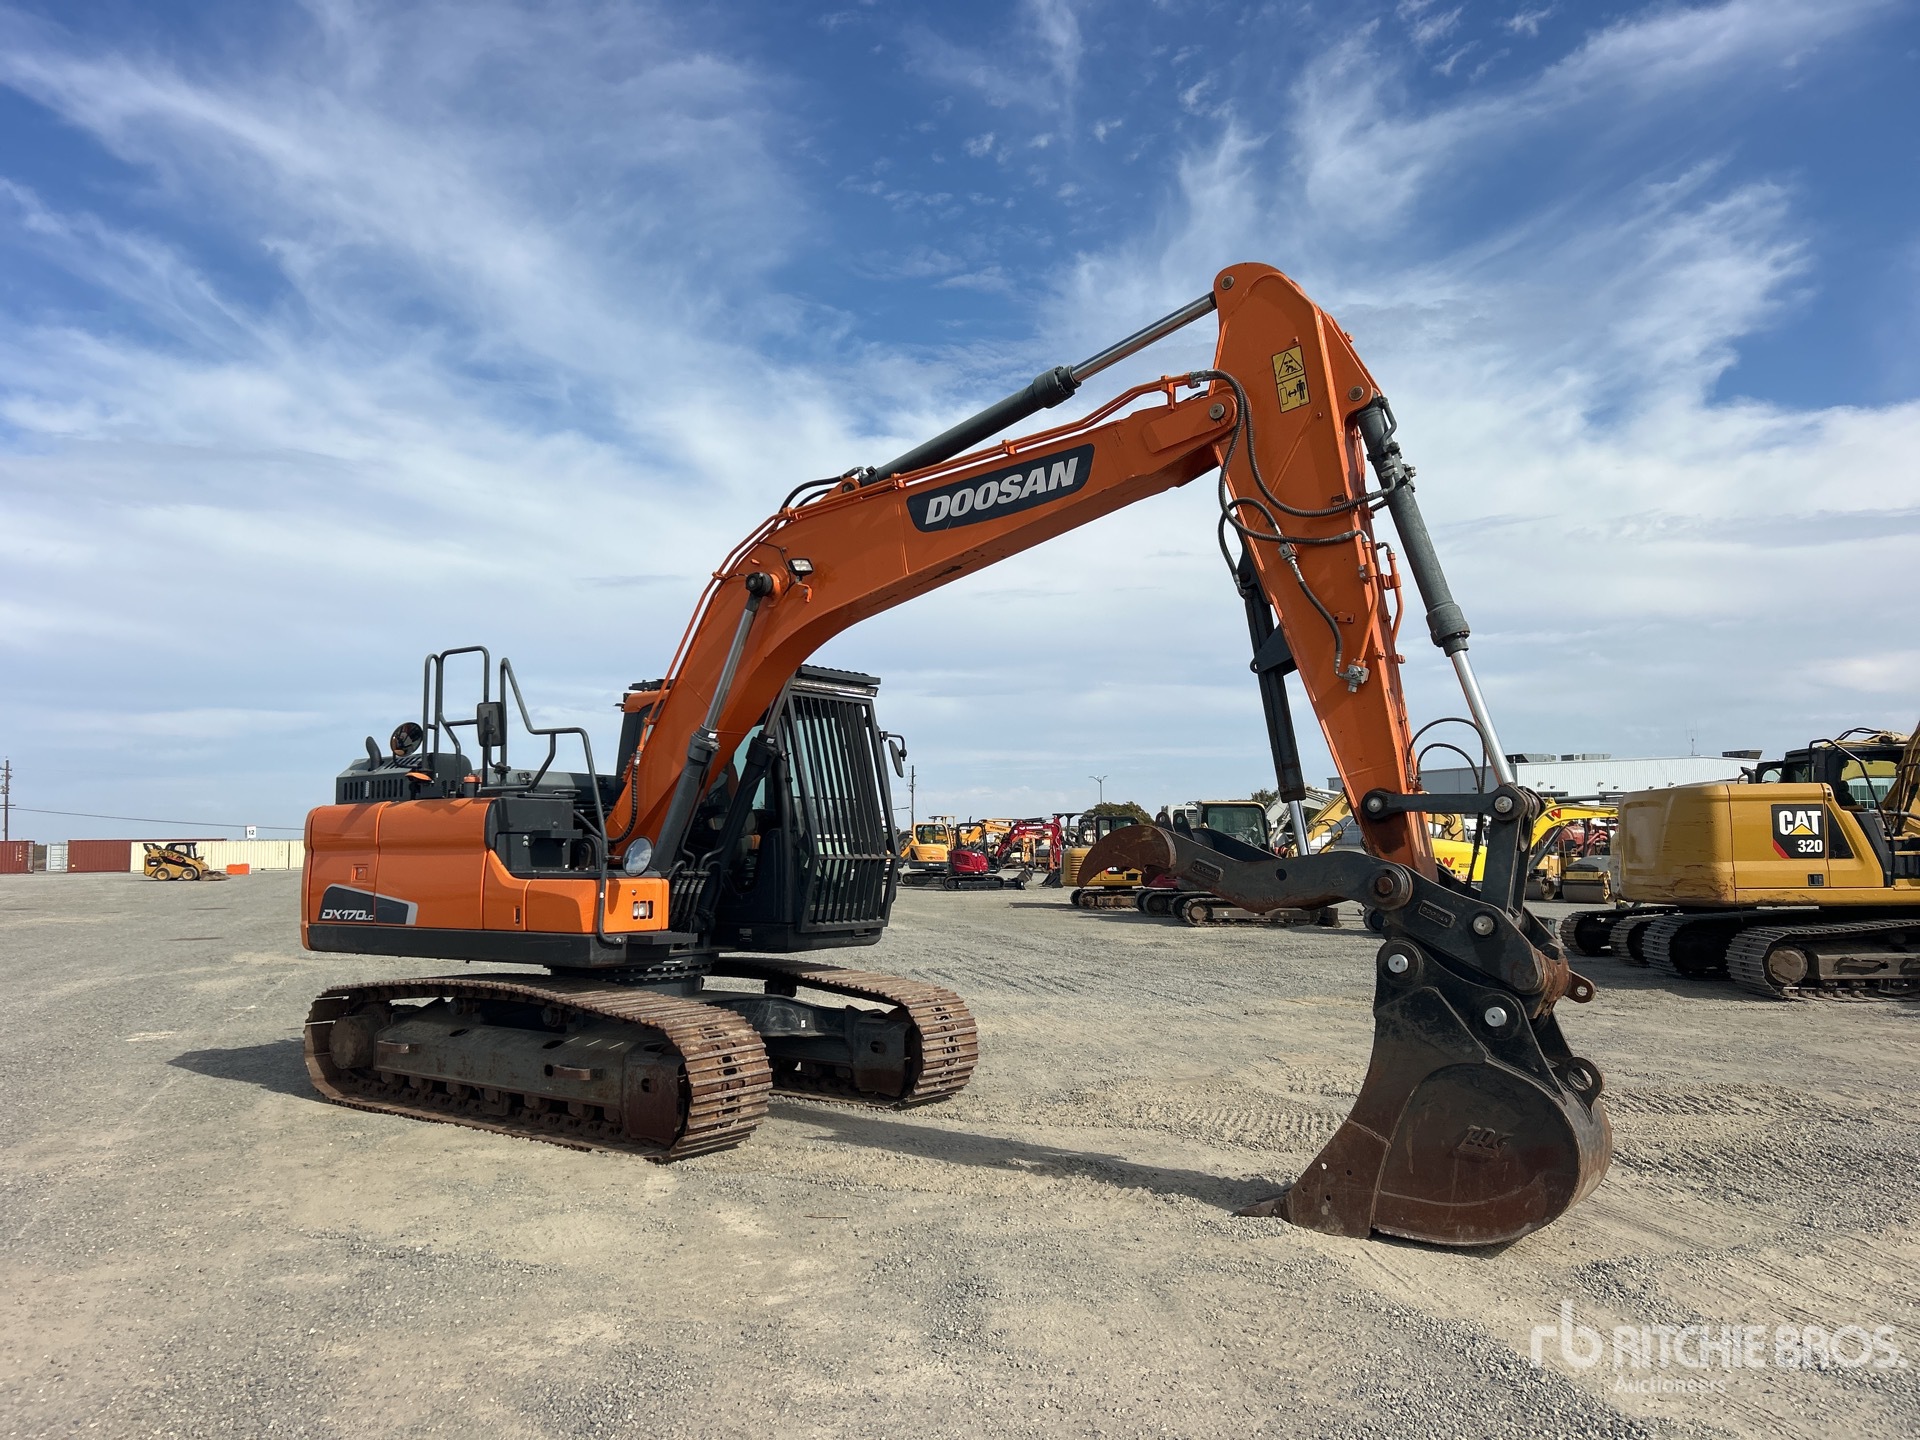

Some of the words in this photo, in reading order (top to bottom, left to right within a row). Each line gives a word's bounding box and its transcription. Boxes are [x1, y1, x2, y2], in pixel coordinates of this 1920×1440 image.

[925, 457, 1078, 525] DOOSAN
[1778, 810, 1822, 836] CAT
[1797, 839, 1823, 853] 320
